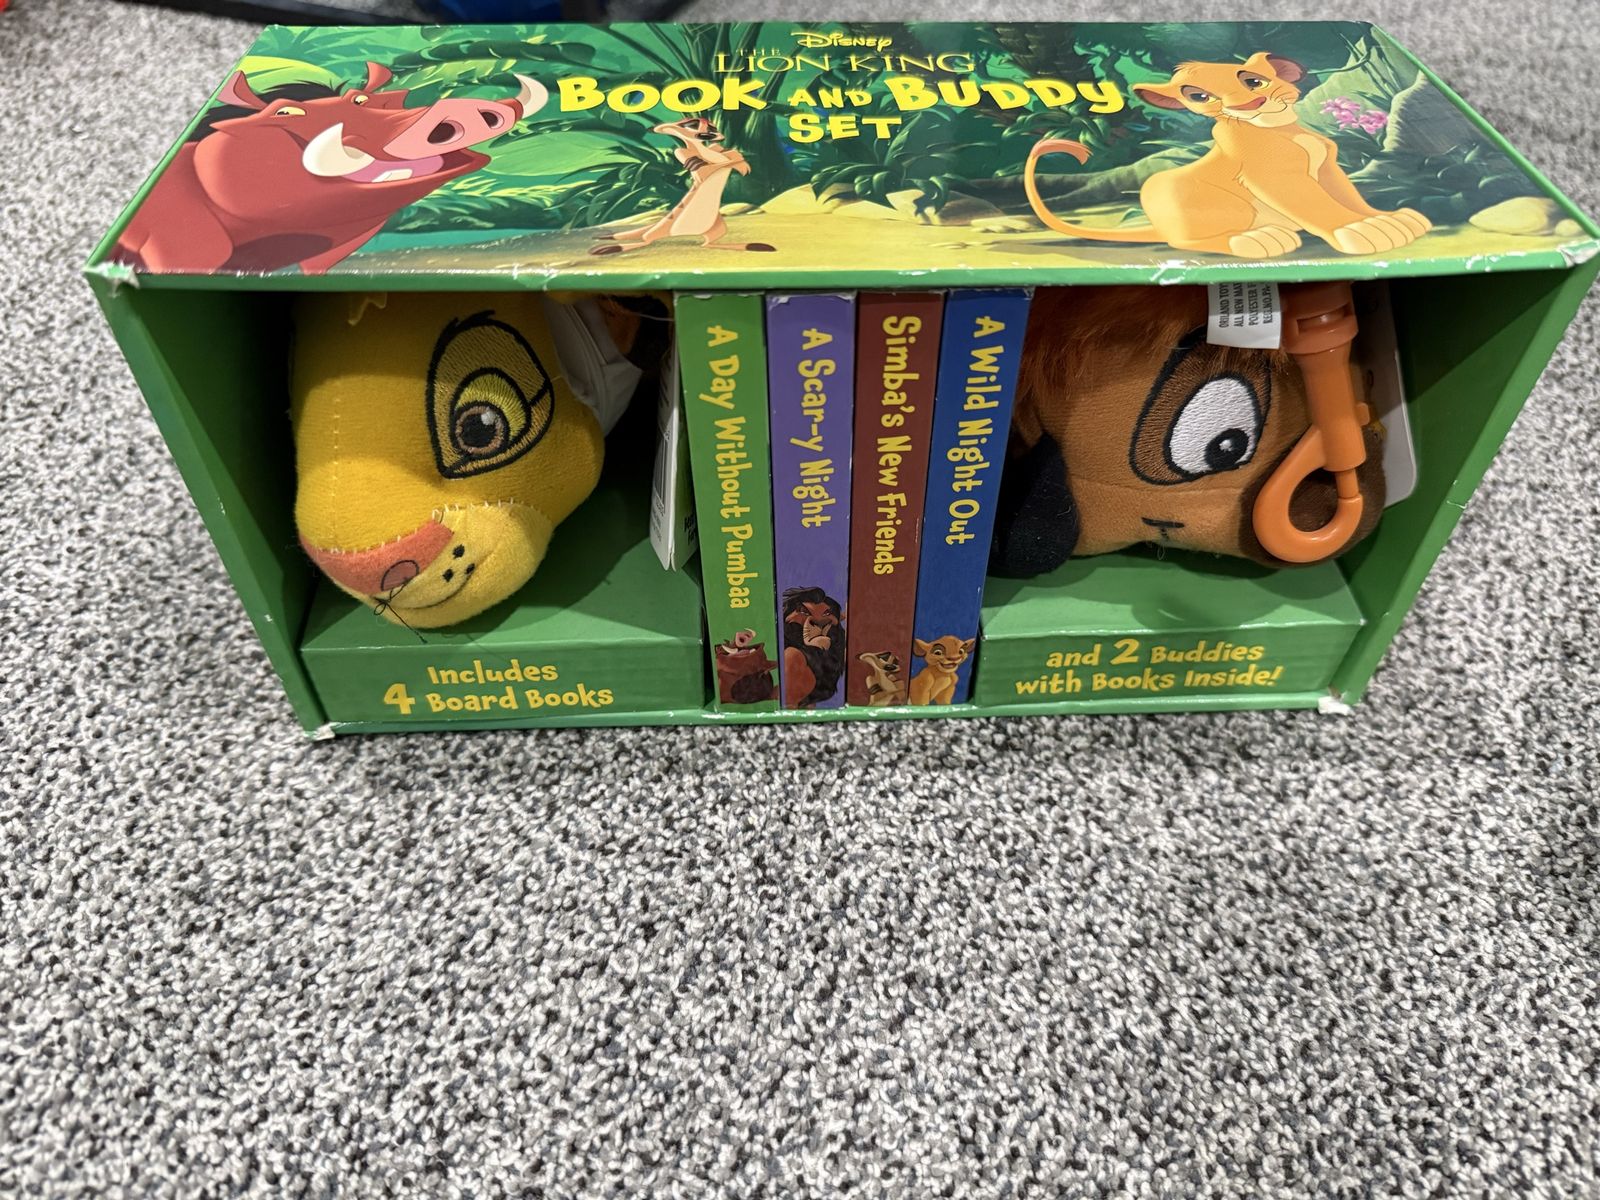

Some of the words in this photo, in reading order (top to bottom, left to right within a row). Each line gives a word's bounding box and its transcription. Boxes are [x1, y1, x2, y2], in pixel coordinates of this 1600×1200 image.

[737, 48, 781, 56] THE
[790, 32, 893, 51] Disney
[714, 53, 832, 73] LION
[848, 53, 975, 73] KING
[557, 76, 769, 114] BOOK
[787, 88, 872, 109] AND
[884, 76, 1126, 114] BUDDY
[787, 113, 902, 144] SET
[1233, 298, 1244, 315] NEW
[1233, 315, 1244, 328] ALL
[1248, 289, 1259, 326] POLYESTER
[706, 325, 739, 347] A
[801, 328, 833, 351] A
[973, 316, 1006, 338] A
[699, 354, 740, 410] Day
[880, 315, 922, 428] Simba's
[963, 345, 1005, 411] Wild
[789, 358, 836, 452] Scar-y
[713, 416, 753, 520] Without
[876, 435, 913, 487] New
[946, 418, 993, 493] Night
[792, 458, 836, 529] Night
[873, 492, 907, 576] Friends
[944, 498, 980, 545] Out
[721, 522, 758, 609] Pumbaa
[1046, 643, 1102, 668] and
[1110, 638, 1140, 666] 2
[1150, 640, 1265, 664] Buddies
[426, 659, 559, 684] Includes
[1015, 669, 1081, 695] with
[1092, 668, 1175, 691] Books
[1184, 664, 1284, 687] Inside!
[383, 683, 416, 715] 4
[425, 686, 519, 712] Board
[525, 683, 614, 709] Books
